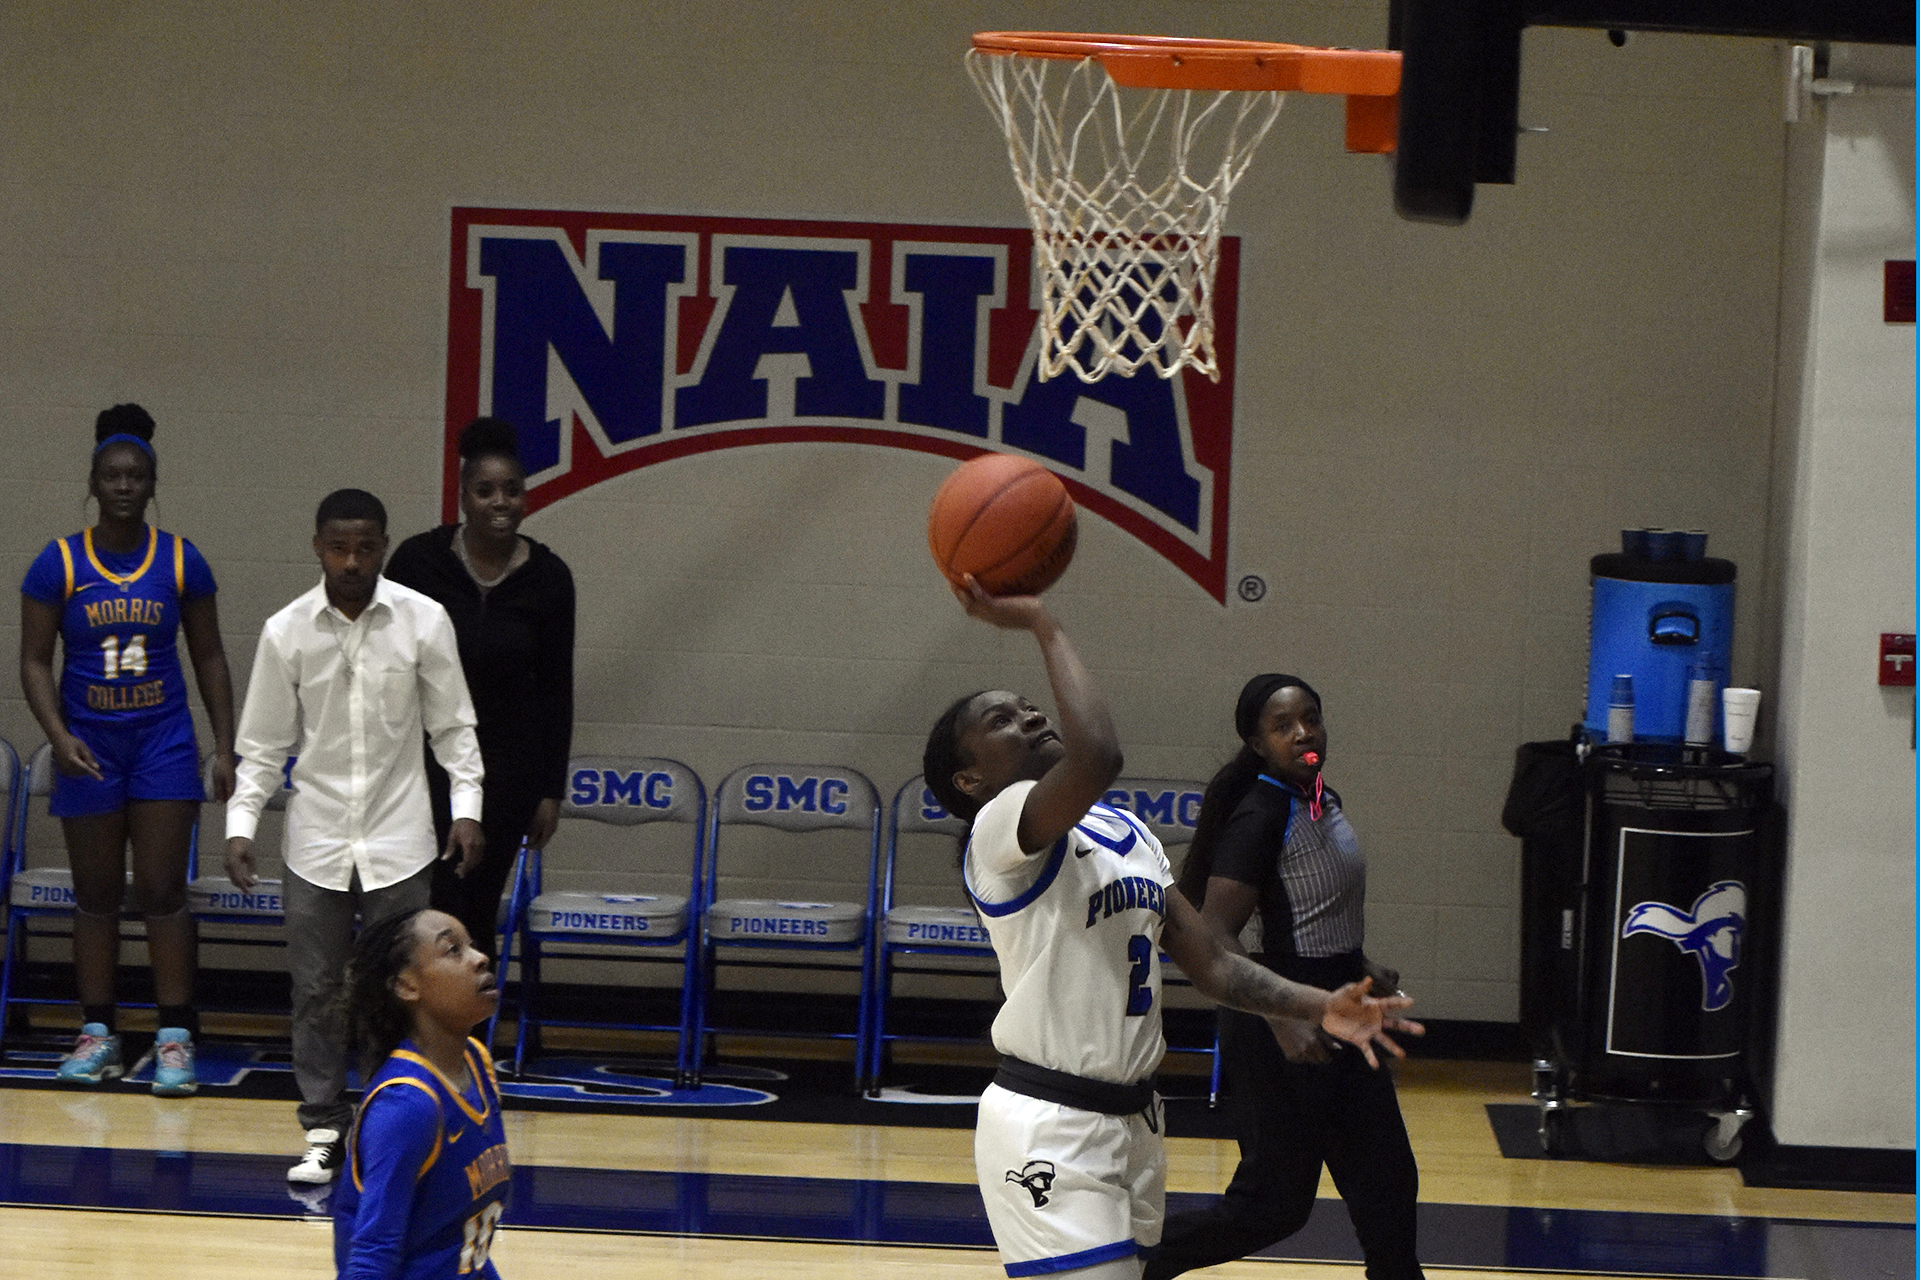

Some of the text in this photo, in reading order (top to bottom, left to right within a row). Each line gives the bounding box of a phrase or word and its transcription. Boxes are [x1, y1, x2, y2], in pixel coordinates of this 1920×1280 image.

[480, 236, 1202, 534] NAIA
[84, 597, 165, 628] MORRIS
[101, 633, 148, 680] 14
[87, 680, 165, 711] COLLEGE
[570, 768, 674, 811] SMC
[744, 773, 849, 816] SMC
[31, 886, 75, 903] PION
[210, 892, 284, 911] PIONEE
[1086, 876, 1167, 929] PIONEER
[551, 910, 649, 931] PIONEERS
[730, 916, 828, 936] PIONEERS
[1126, 934, 1153, 1016] 2
